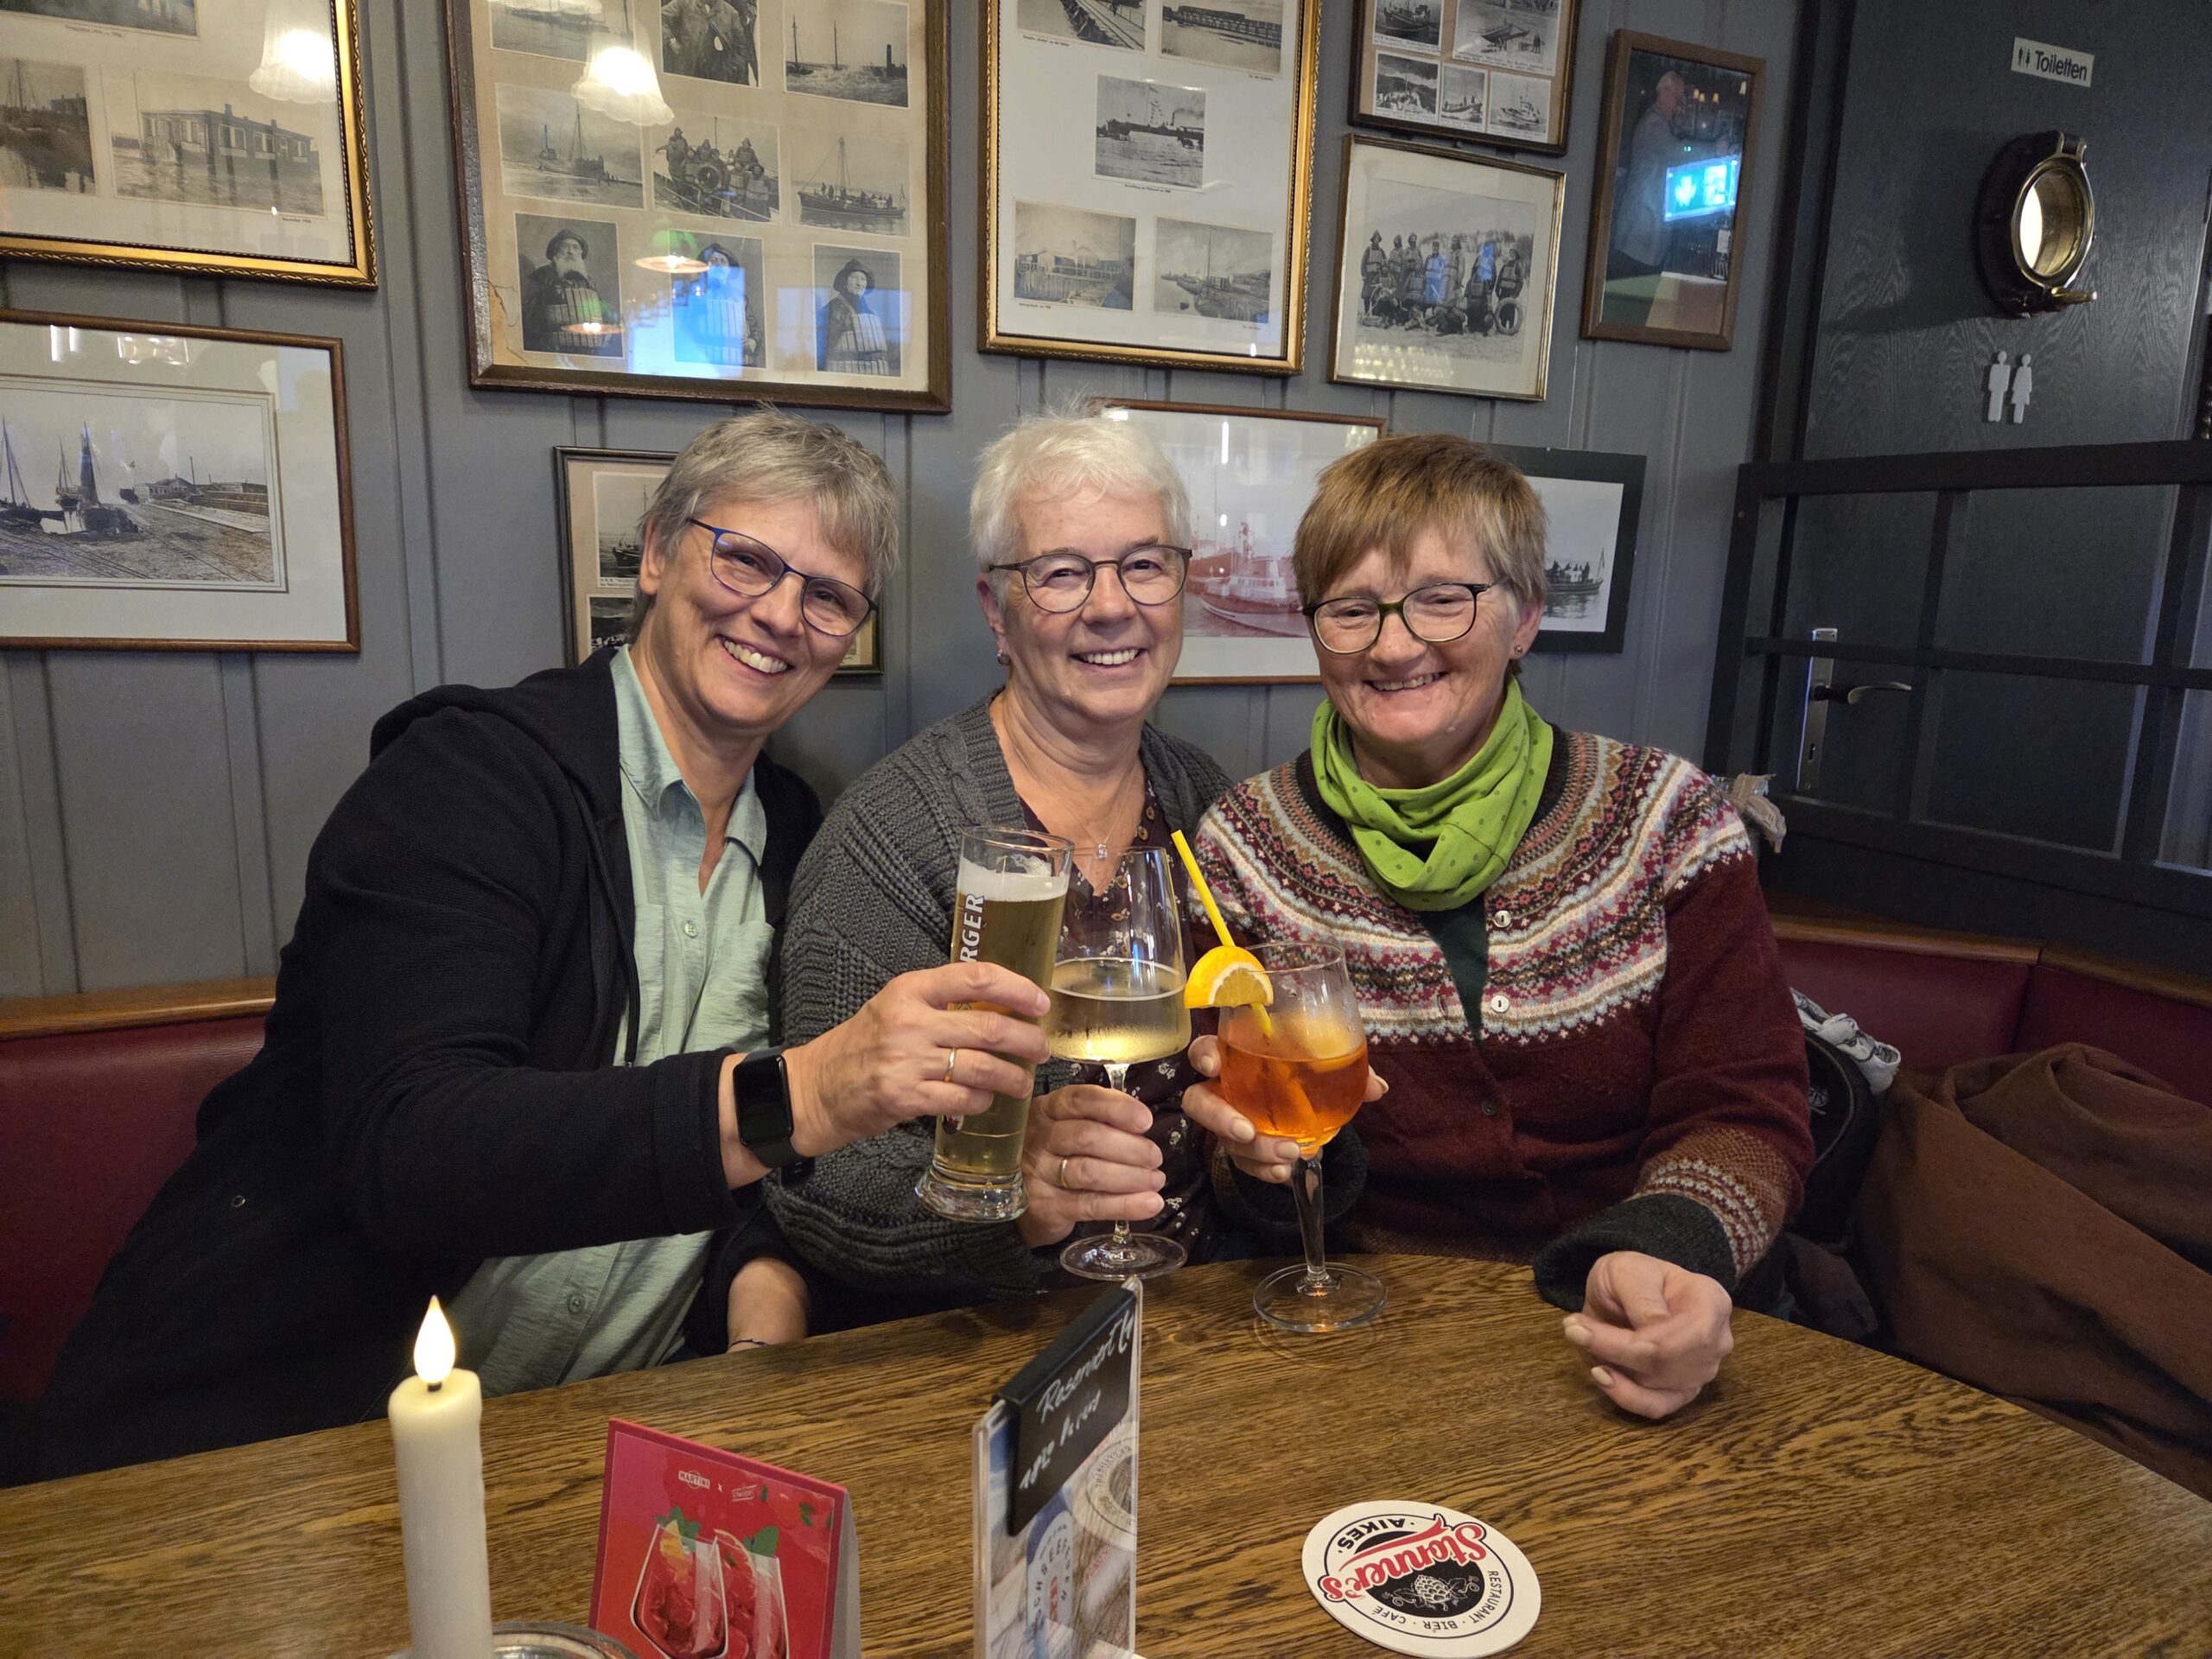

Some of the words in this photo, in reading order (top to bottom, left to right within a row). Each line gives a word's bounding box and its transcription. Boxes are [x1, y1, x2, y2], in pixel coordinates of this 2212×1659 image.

[2035, 51, 2088, 81] Toiletten
[959, 893, 985, 963] RGER
[678, 1471, 710, 1489] MARTINI
[1338, 1517, 1407, 1550] AIKES
[1321, 1523, 1488, 1600] Stonner's
[1468, 1569, 1503, 1624] RESTAURANT
[1370, 1604, 1408, 1624] CAFÉ
[1423, 1620, 1459, 1631] BIER
